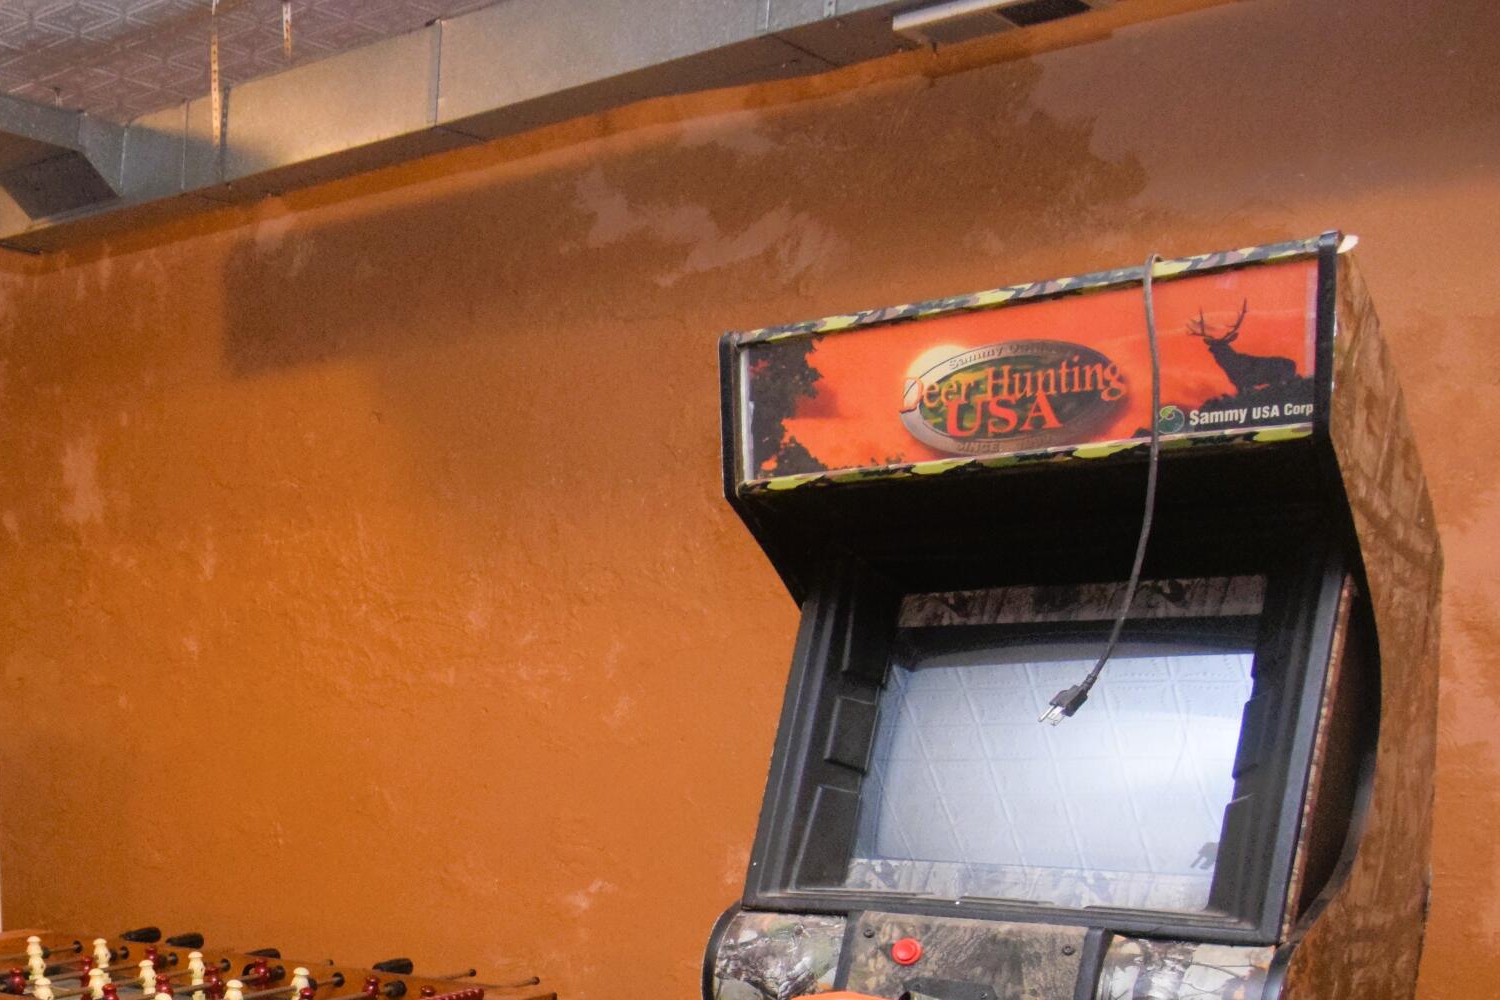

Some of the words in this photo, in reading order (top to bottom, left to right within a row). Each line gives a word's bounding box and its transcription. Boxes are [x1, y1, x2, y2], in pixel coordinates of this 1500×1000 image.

[900, 377, 976, 413] Deer
[985, 355, 1127, 402] Hunting
[946, 391, 1064, 438] USA
[1189, 407, 1248, 426] Sammy
[1251, 404, 1280, 419] USA
[1283, 402, 1314, 416] Corp
